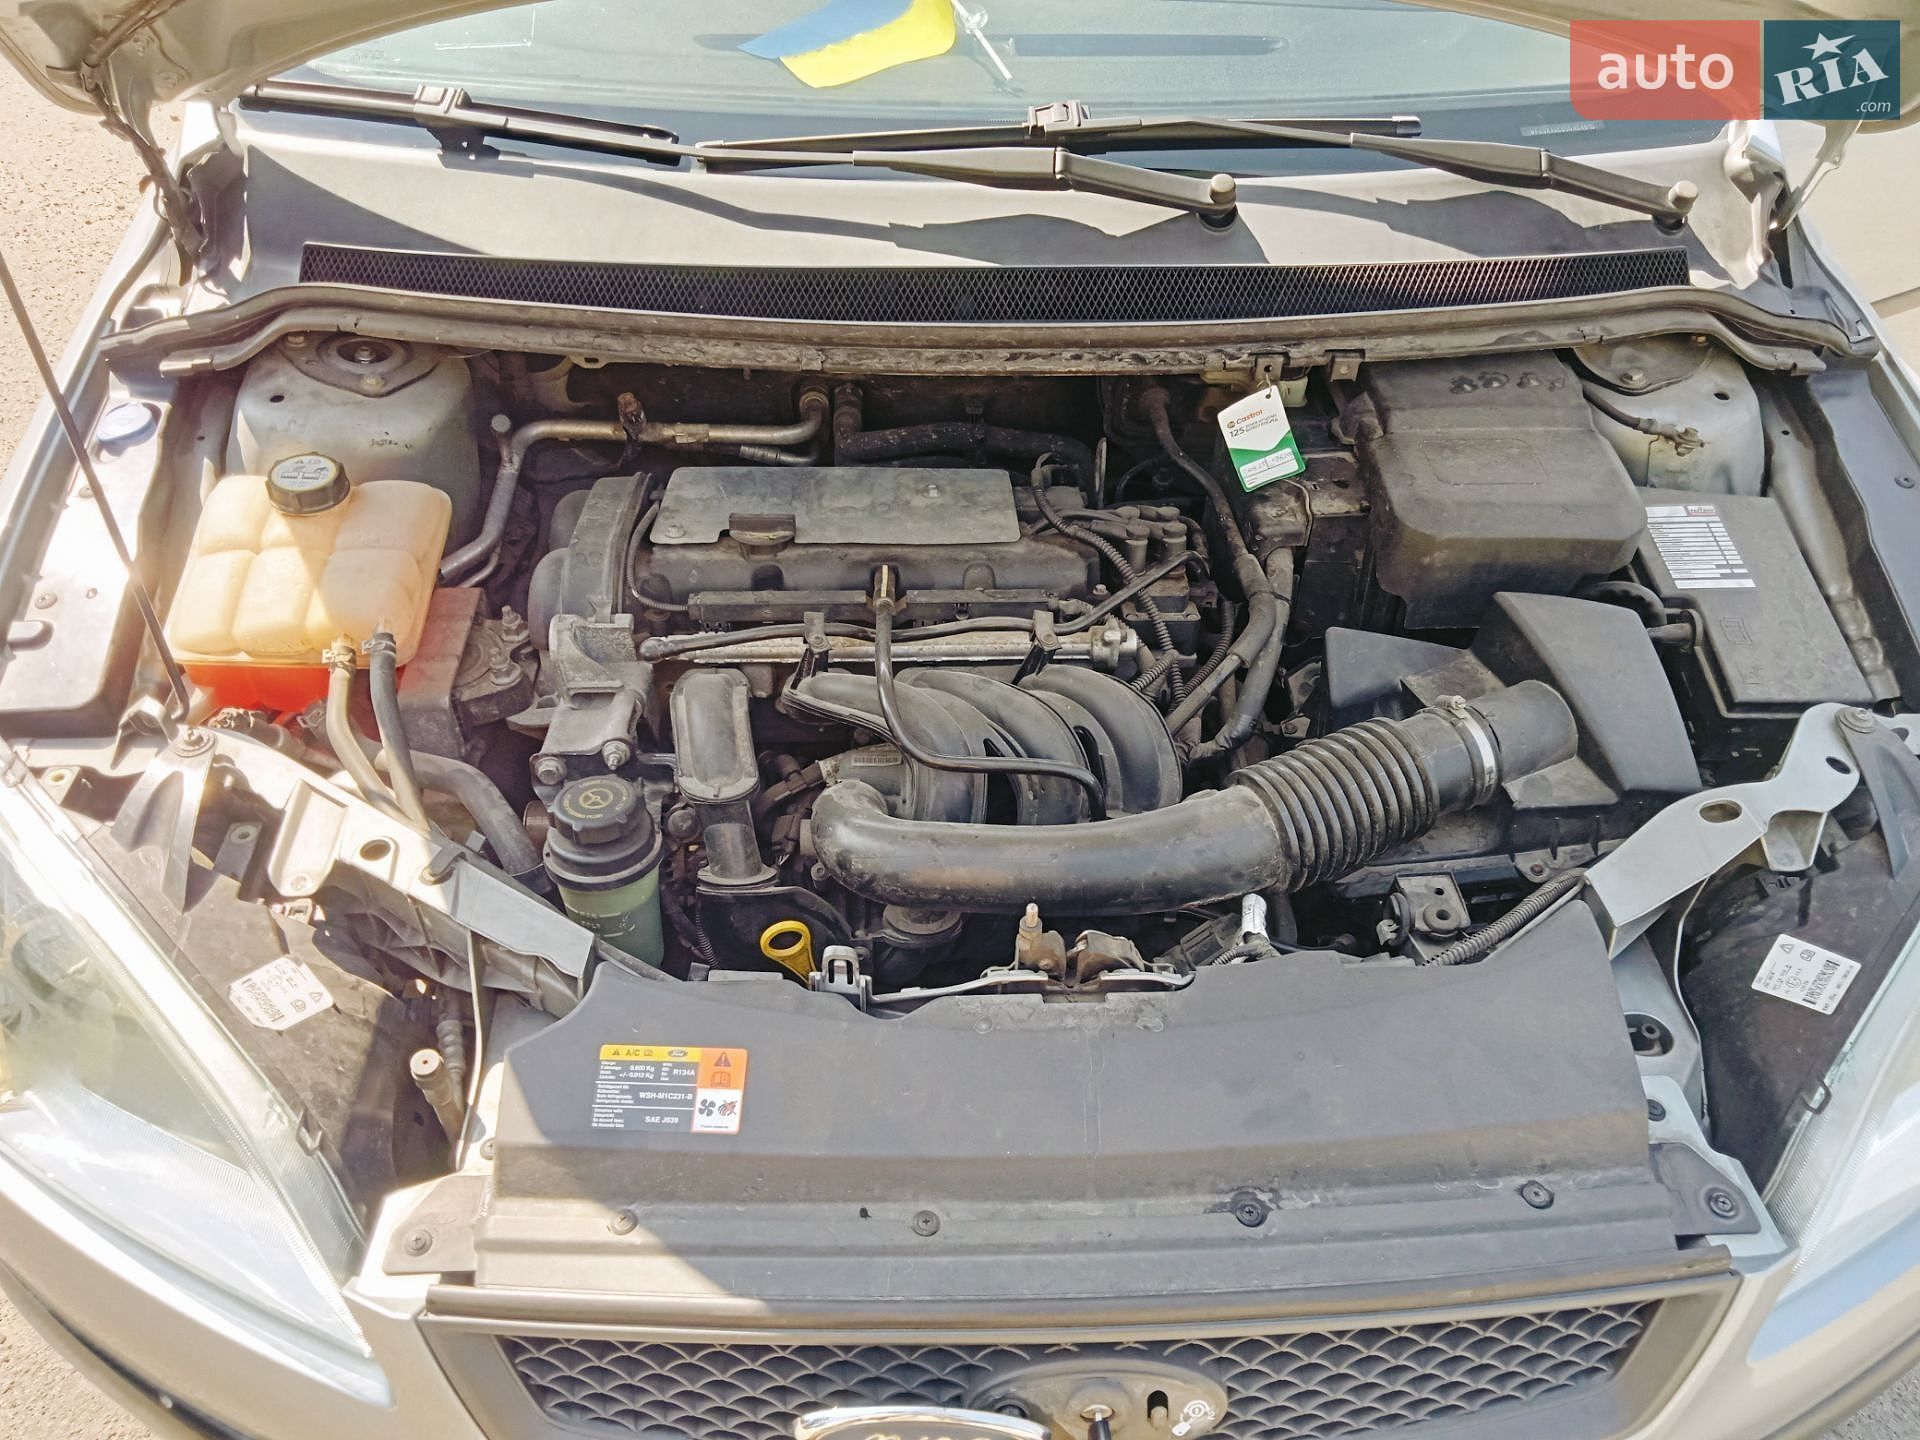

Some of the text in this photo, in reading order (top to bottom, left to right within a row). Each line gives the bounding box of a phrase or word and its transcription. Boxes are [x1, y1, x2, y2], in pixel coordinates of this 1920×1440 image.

[1236, 408, 1264, 425] Castrol
[1229, 425, 1246, 438] 125
[625, 1049, 641, 1057] A/C
[673, 1068, 696, 1076] R134A
[645, 1115, 661, 1124] SAE
